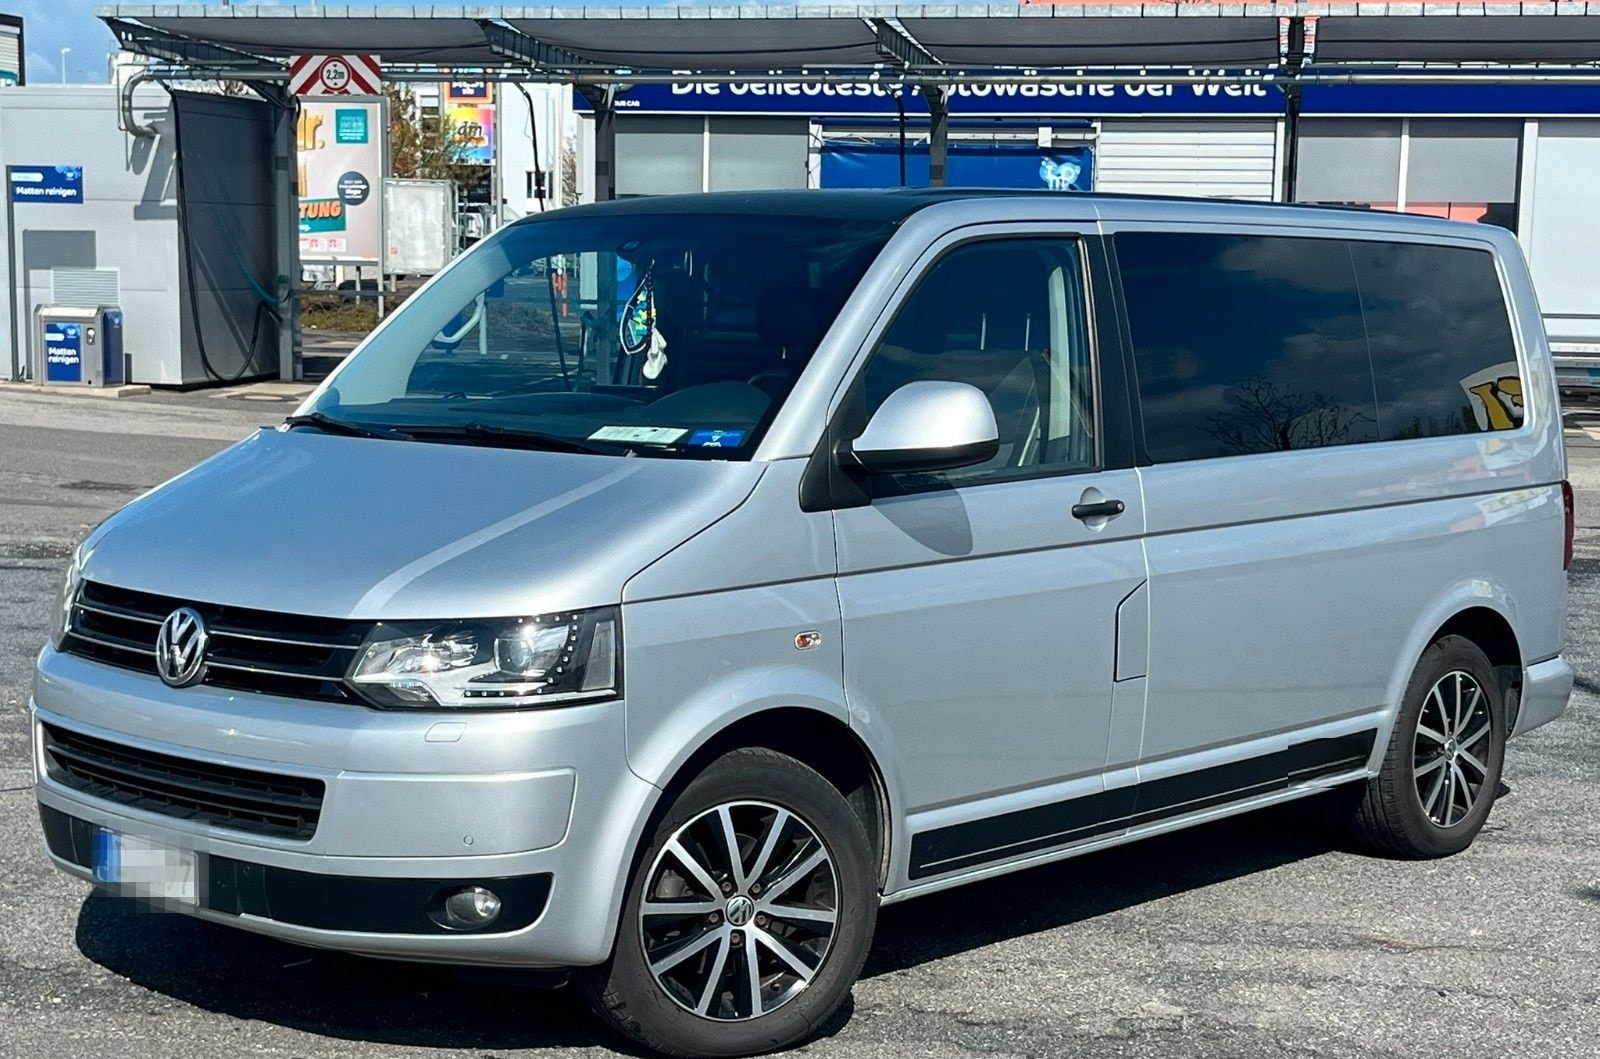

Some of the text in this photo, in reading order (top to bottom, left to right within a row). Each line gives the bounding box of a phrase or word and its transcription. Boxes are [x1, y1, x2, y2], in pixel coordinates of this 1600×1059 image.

[672, 69, 721, 95] Die
[911, 70, 1115, 97] towäsche
[1124, 69, 1173, 97] der
[1191, 69, 1267, 97] Welt
[16, 187, 77, 198] Matten reinigen
[48, 347, 77, 356] Matten
[48, 355, 80, 365] reinigen
